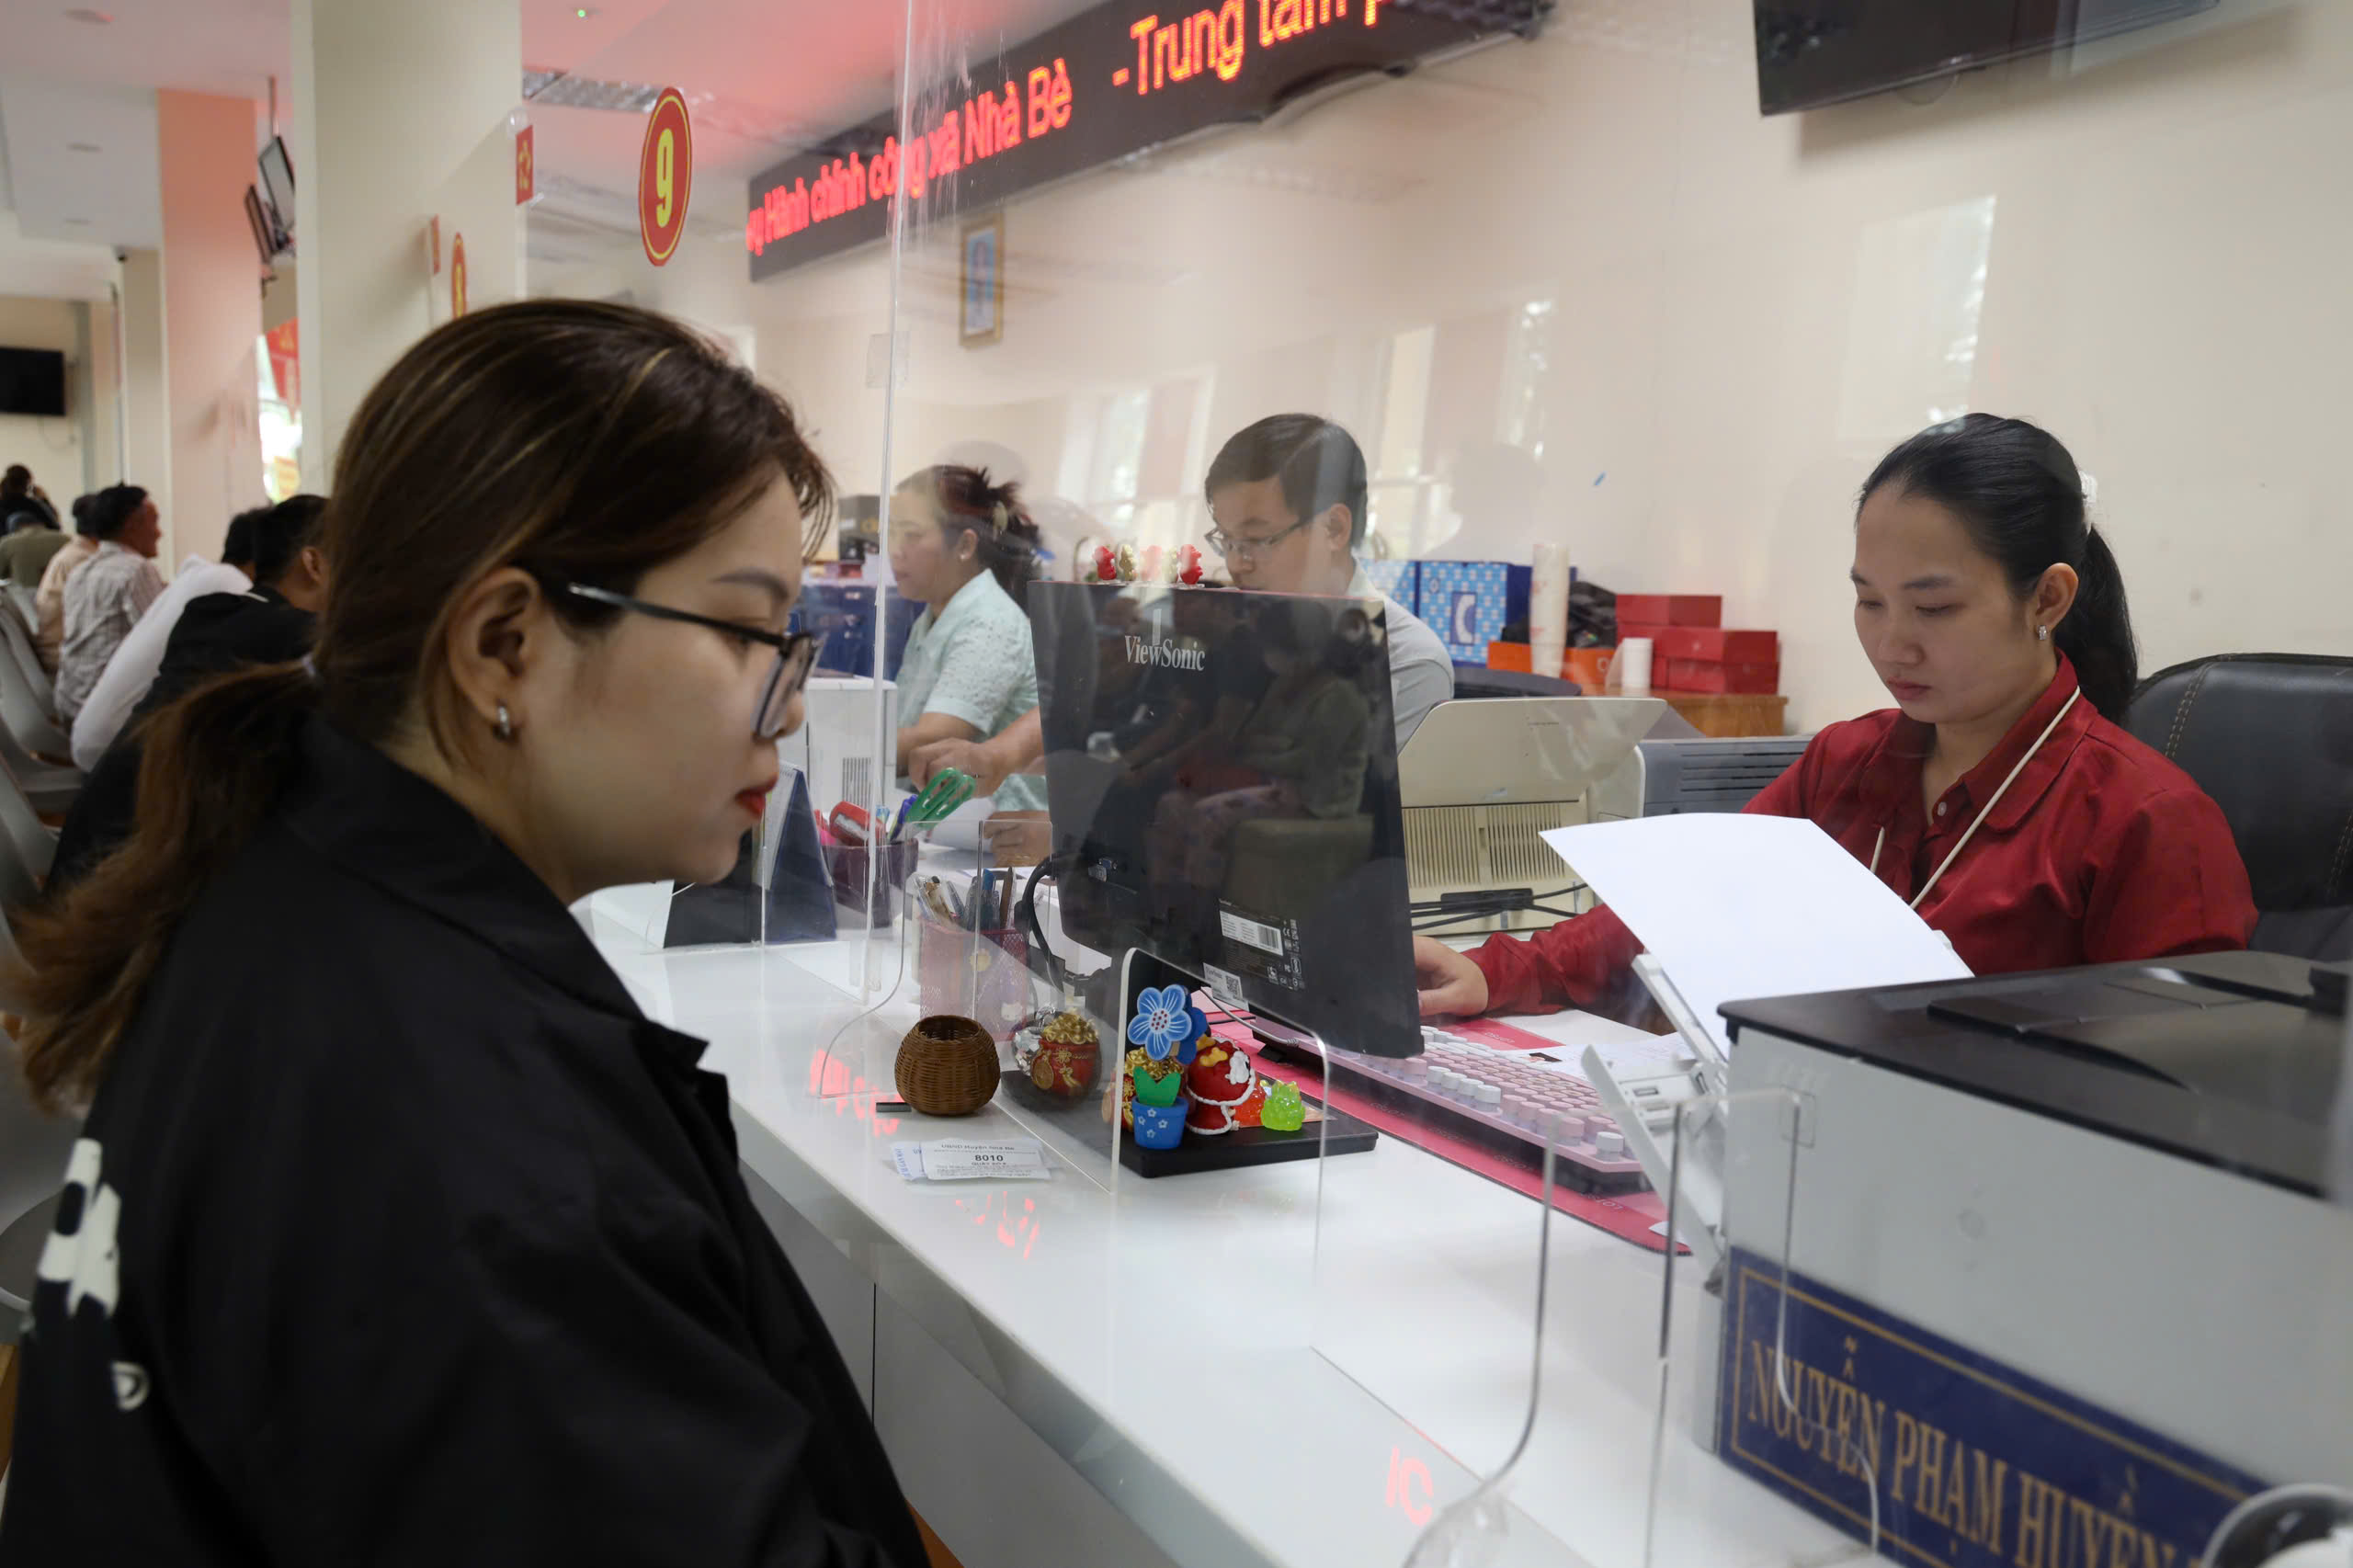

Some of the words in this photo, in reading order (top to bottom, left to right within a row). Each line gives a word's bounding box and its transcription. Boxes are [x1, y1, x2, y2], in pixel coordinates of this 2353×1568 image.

[656, 128, 674, 229] 9
[811, 152, 866, 222] chính
[869, 136, 926, 199] công
[928, 109, 961, 179] xã
[964, 80, 1021, 165] Nhà
[1028, 58, 1072, 139] Bè
[1124, 634, 1205, 672] ViewSonic
[1747, 1335, 1887, 1486] NGUYỄN
[1890, 1409, 2008, 1555] PHẠM
